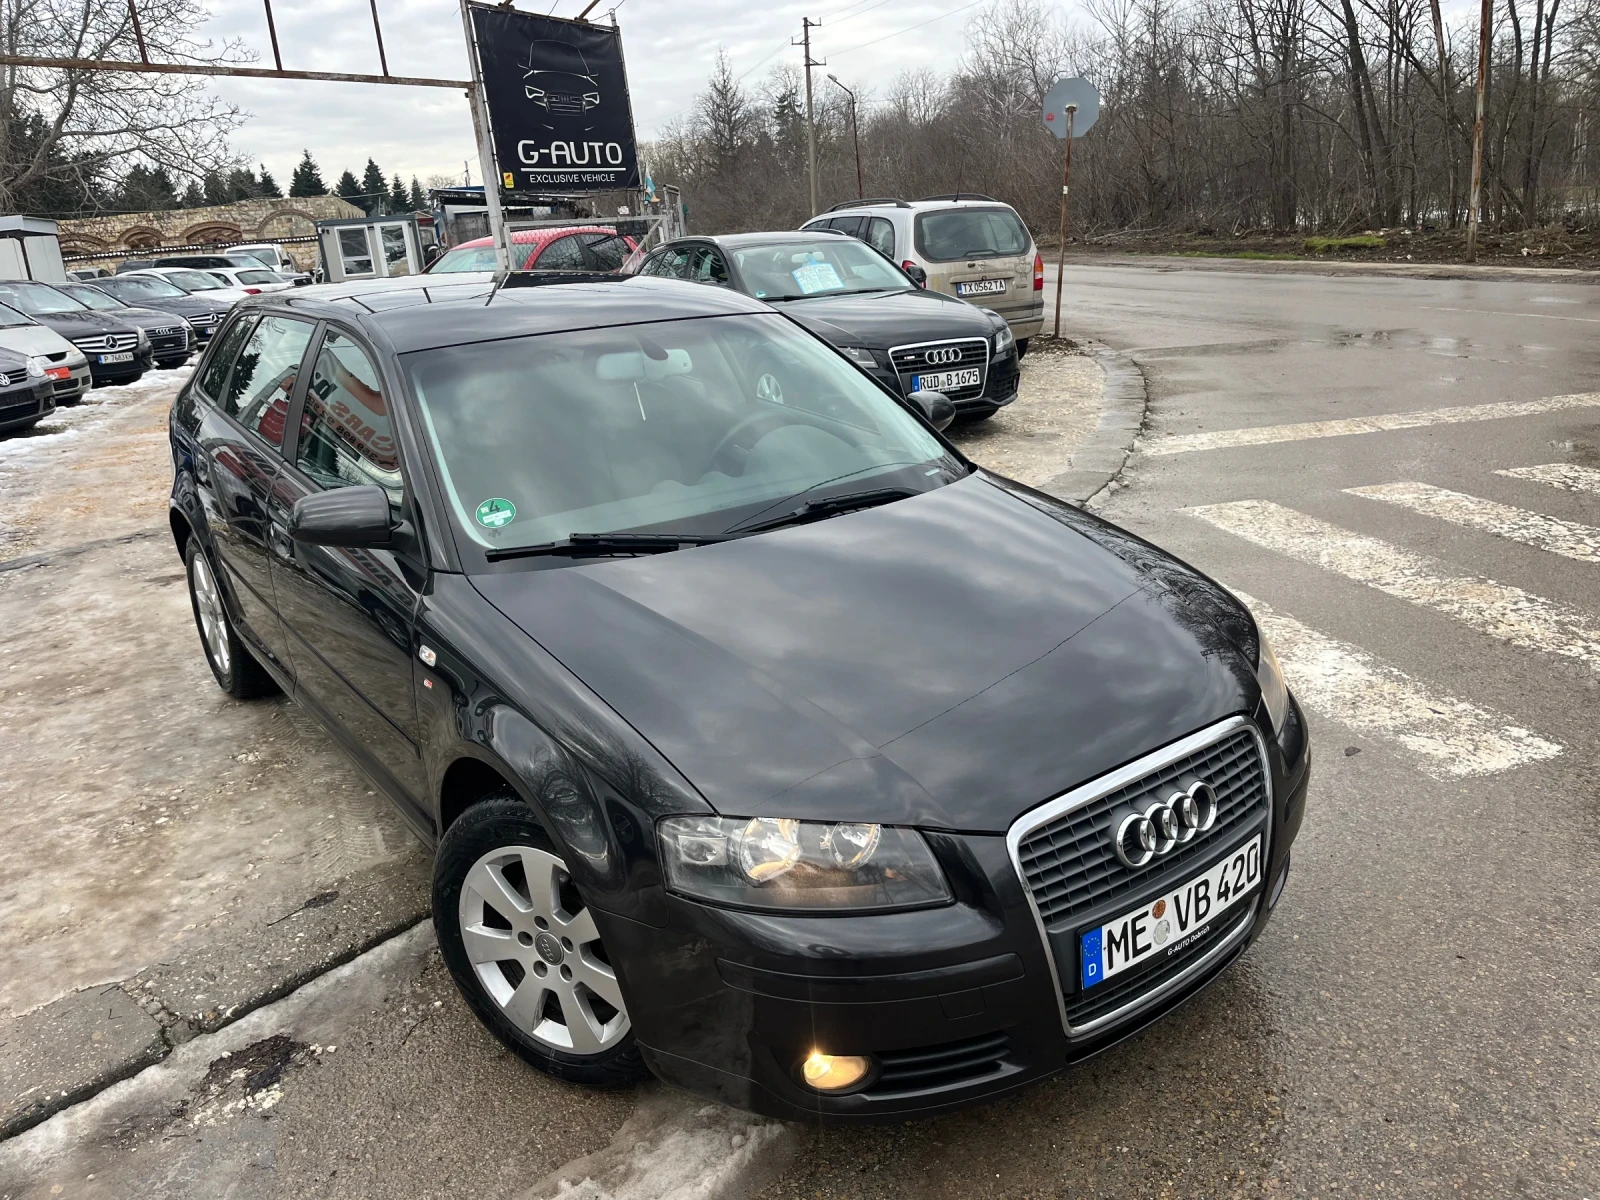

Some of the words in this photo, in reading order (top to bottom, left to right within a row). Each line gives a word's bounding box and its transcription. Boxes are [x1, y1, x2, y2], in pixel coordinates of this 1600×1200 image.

[517, 140, 623, 164] G-AUTO
[529, 174, 580, 183] EXCLUSIVE
[581, 173, 616, 182] VEHICLE
[955, 370, 979, 385] 1675
[489, 500, 500, 512] 4
[1107, 911, 1152, 970] ME
[1174, 878, 1211, 932] VB
[1217, 842, 1258, 903] 420
[1167, 938, 1190, 955] G-AUTO
[1088, 963, 1097, 977] D
